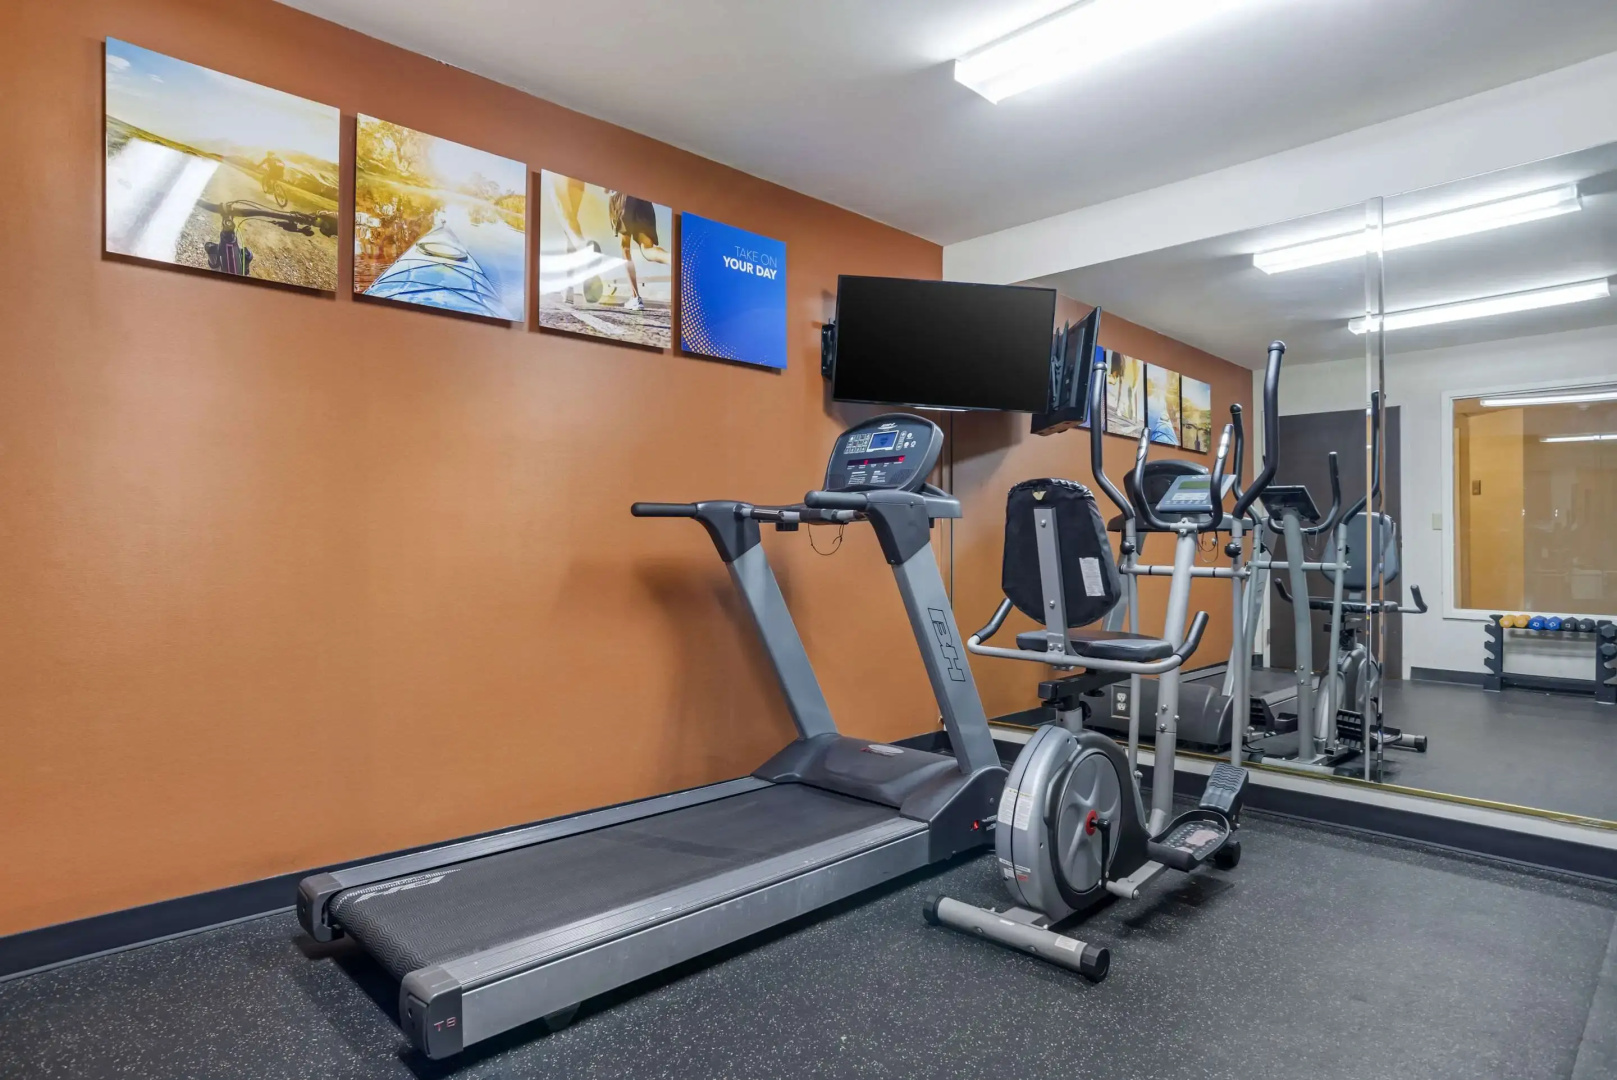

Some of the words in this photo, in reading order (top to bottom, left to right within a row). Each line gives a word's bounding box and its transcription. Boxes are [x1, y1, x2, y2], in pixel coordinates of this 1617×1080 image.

[723, 256, 753, 274] YOUR
[756, 265, 777, 280] DAY
[735, 246, 758, 262] TAKE
[760, 254, 777, 268] ON
